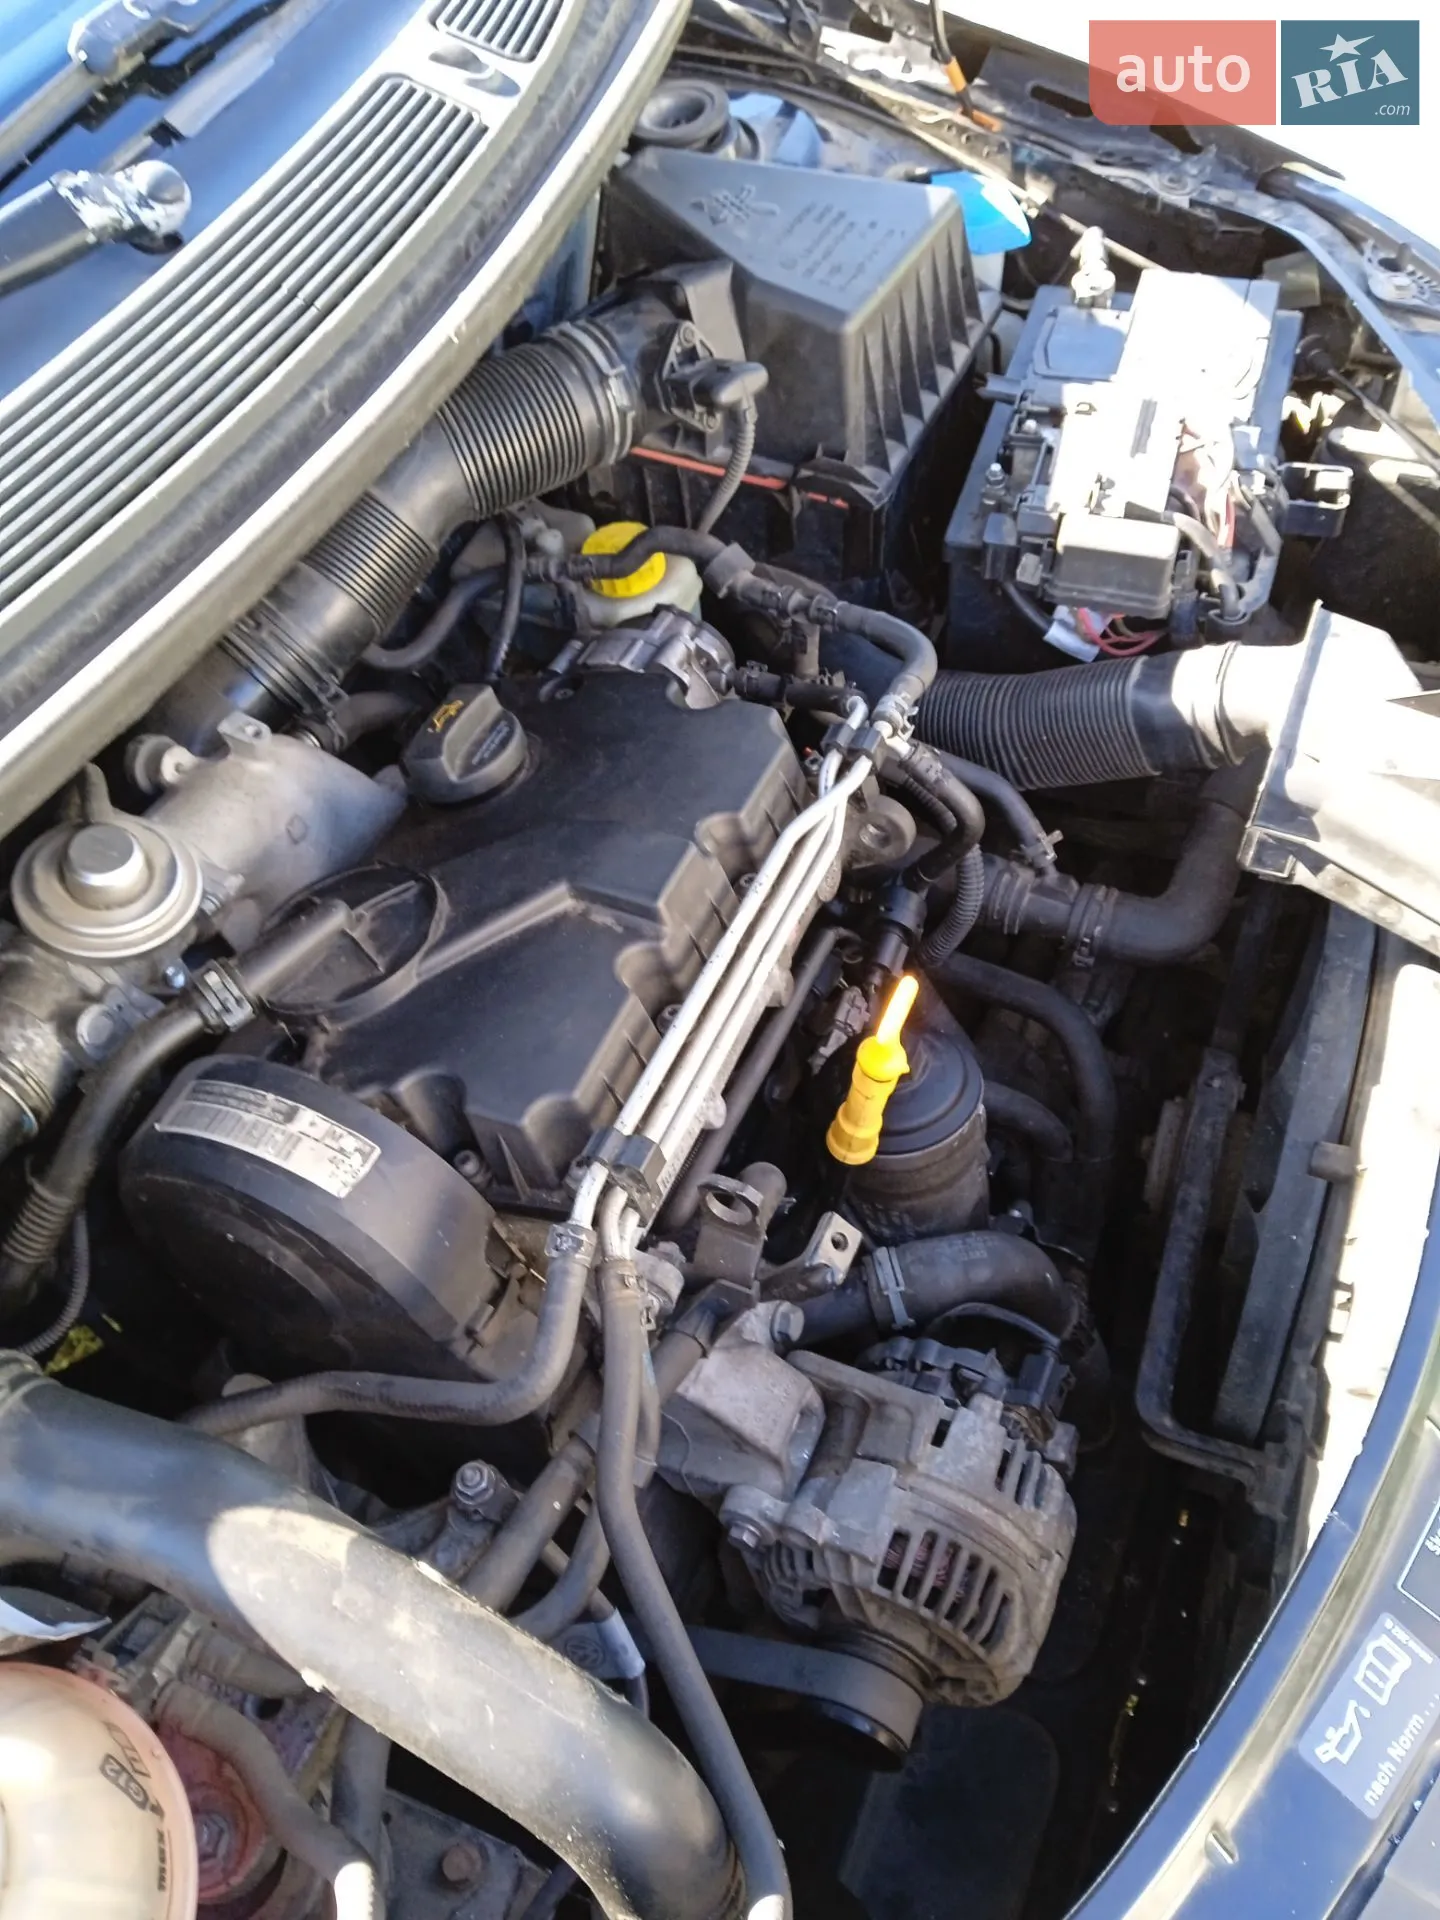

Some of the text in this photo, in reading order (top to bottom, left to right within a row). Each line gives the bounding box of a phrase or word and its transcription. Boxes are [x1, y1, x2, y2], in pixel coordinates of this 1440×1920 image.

[102, 1756, 145, 1804] G12
[1364, 1761, 1397, 1806] nach
[1386, 1713, 1425, 1763] Norm
